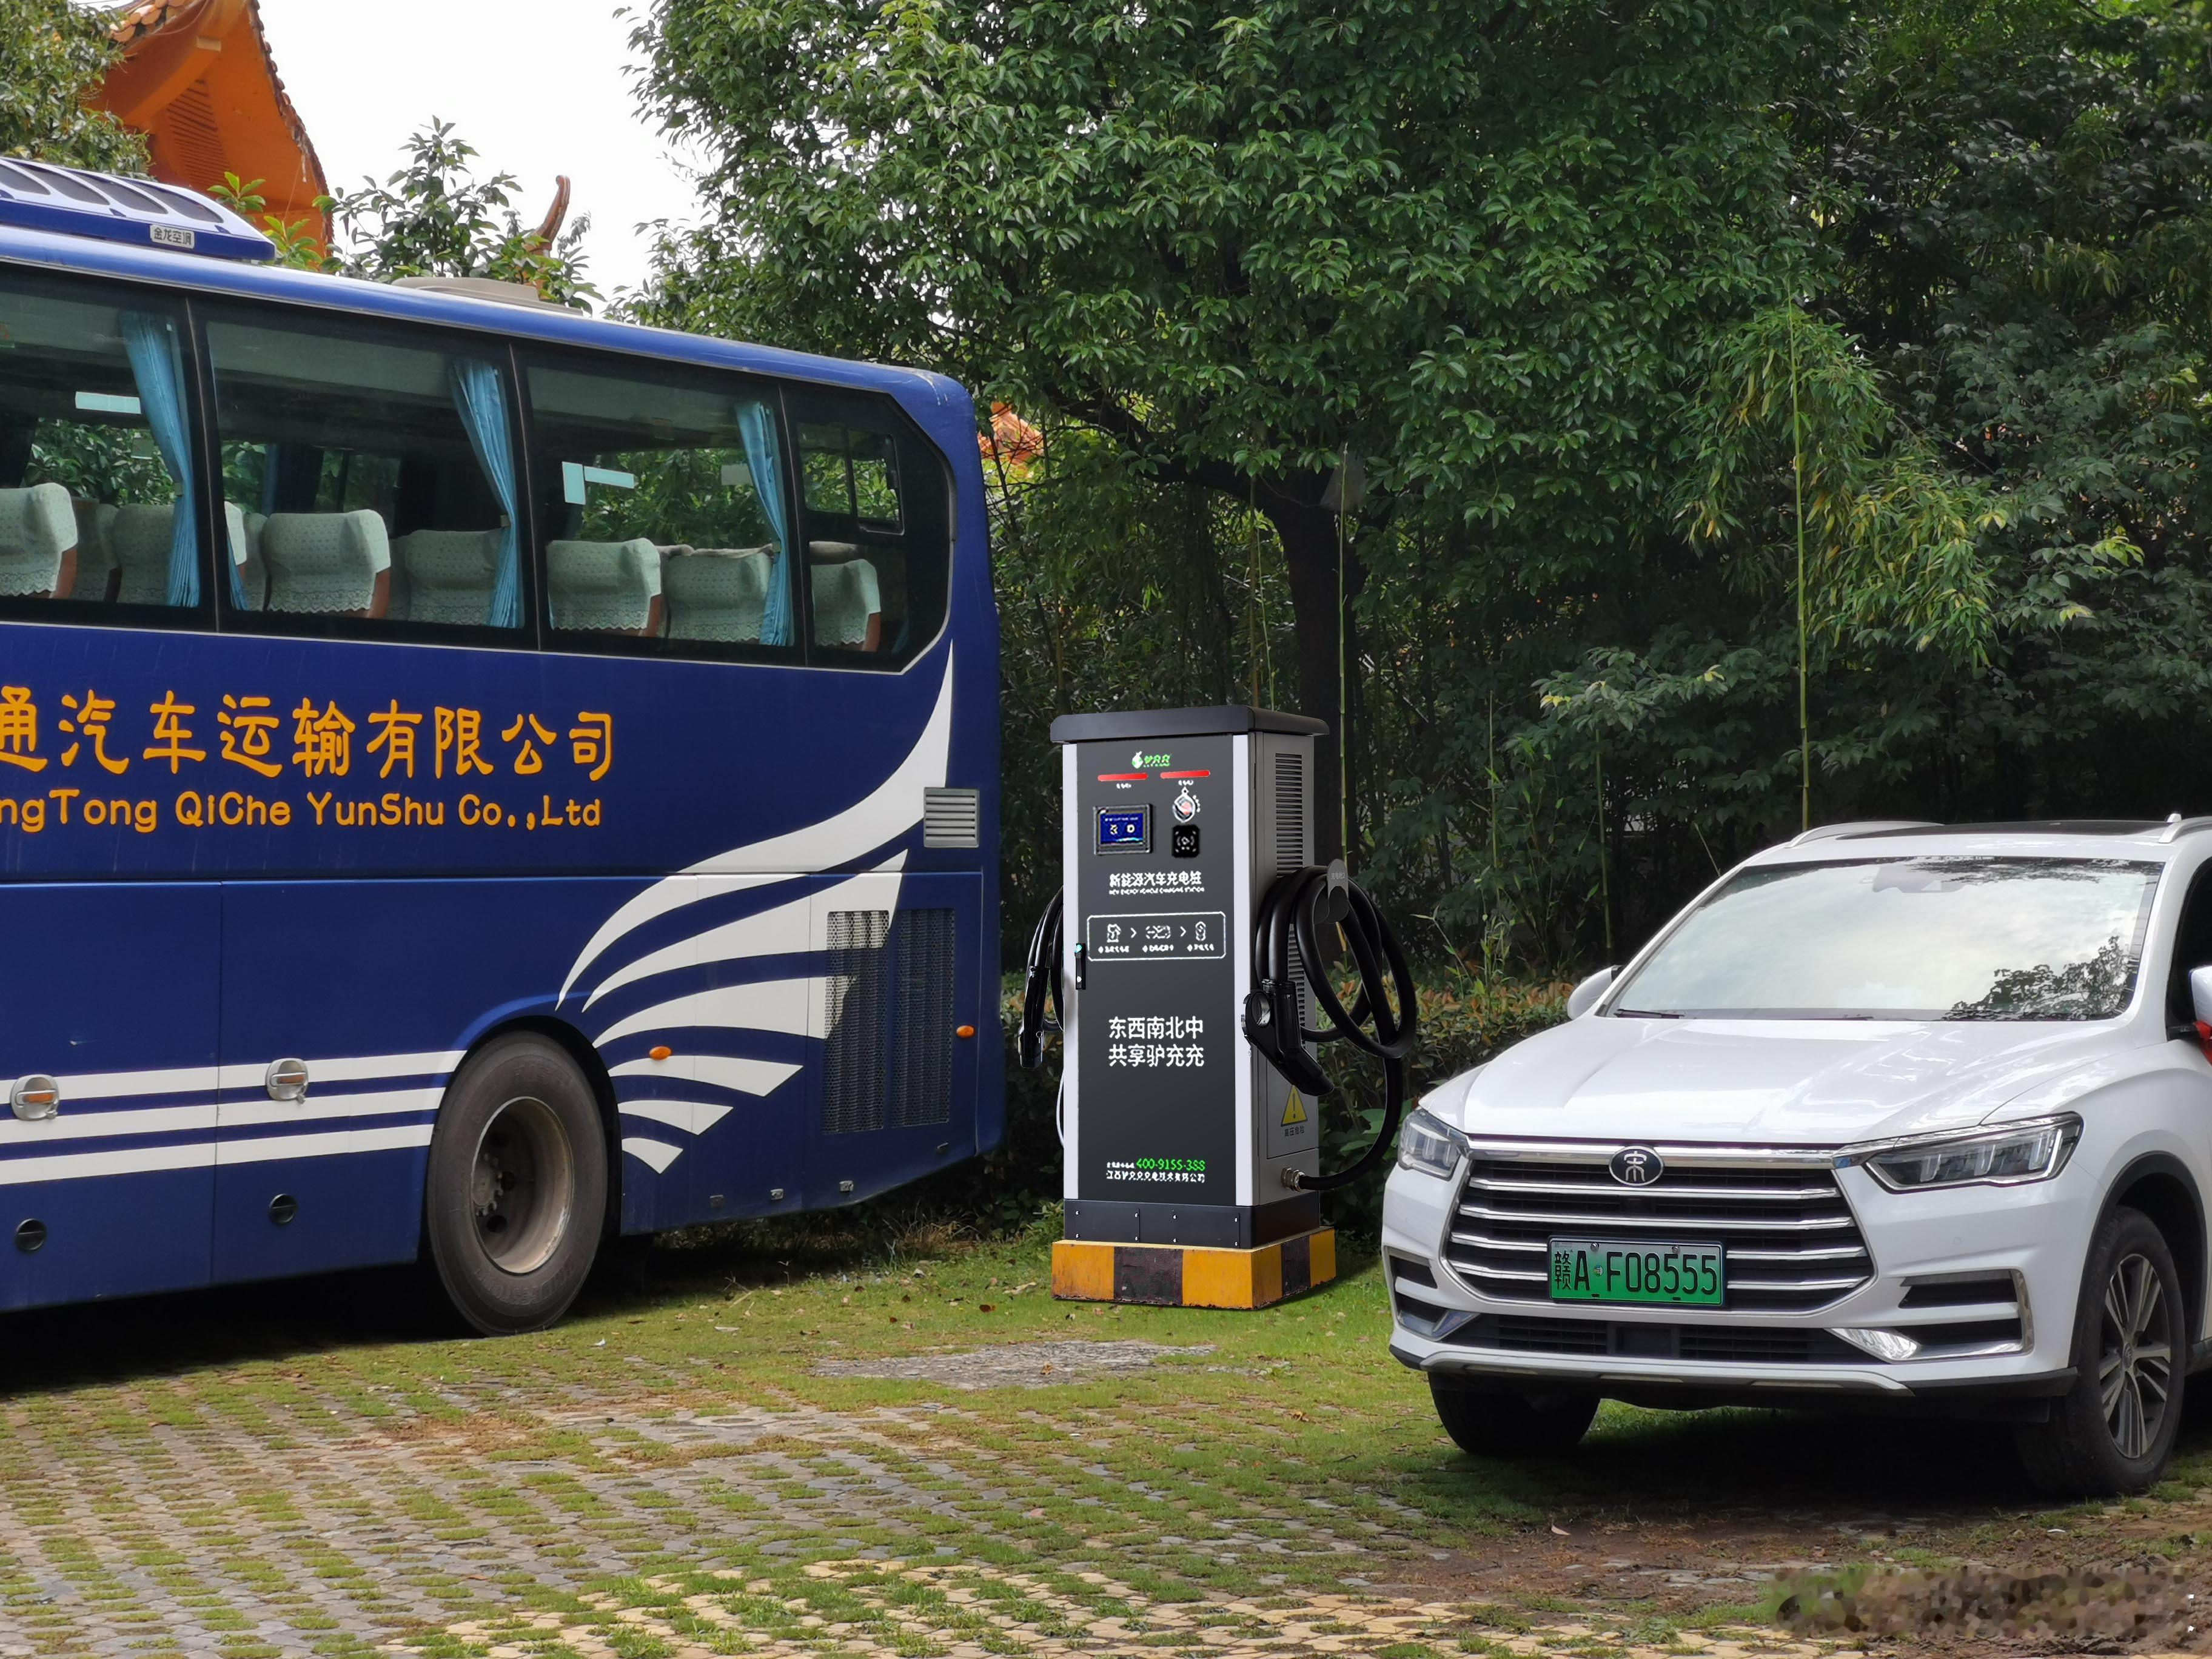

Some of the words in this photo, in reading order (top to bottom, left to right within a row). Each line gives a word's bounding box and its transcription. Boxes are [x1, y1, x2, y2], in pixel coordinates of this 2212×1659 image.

[153, 227, 192, 246] 金龙空调
[0, 686, 612, 781] 通汽车运输有限公司
[0, 789, 157, 833] ngTong
[175, 791, 290, 827] QiChe
[307, 792, 444, 826] YunShu
[1108, 1016, 1204, 1039] 东西南北中
[1108, 1043, 1205, 1067] 共享驴充充
